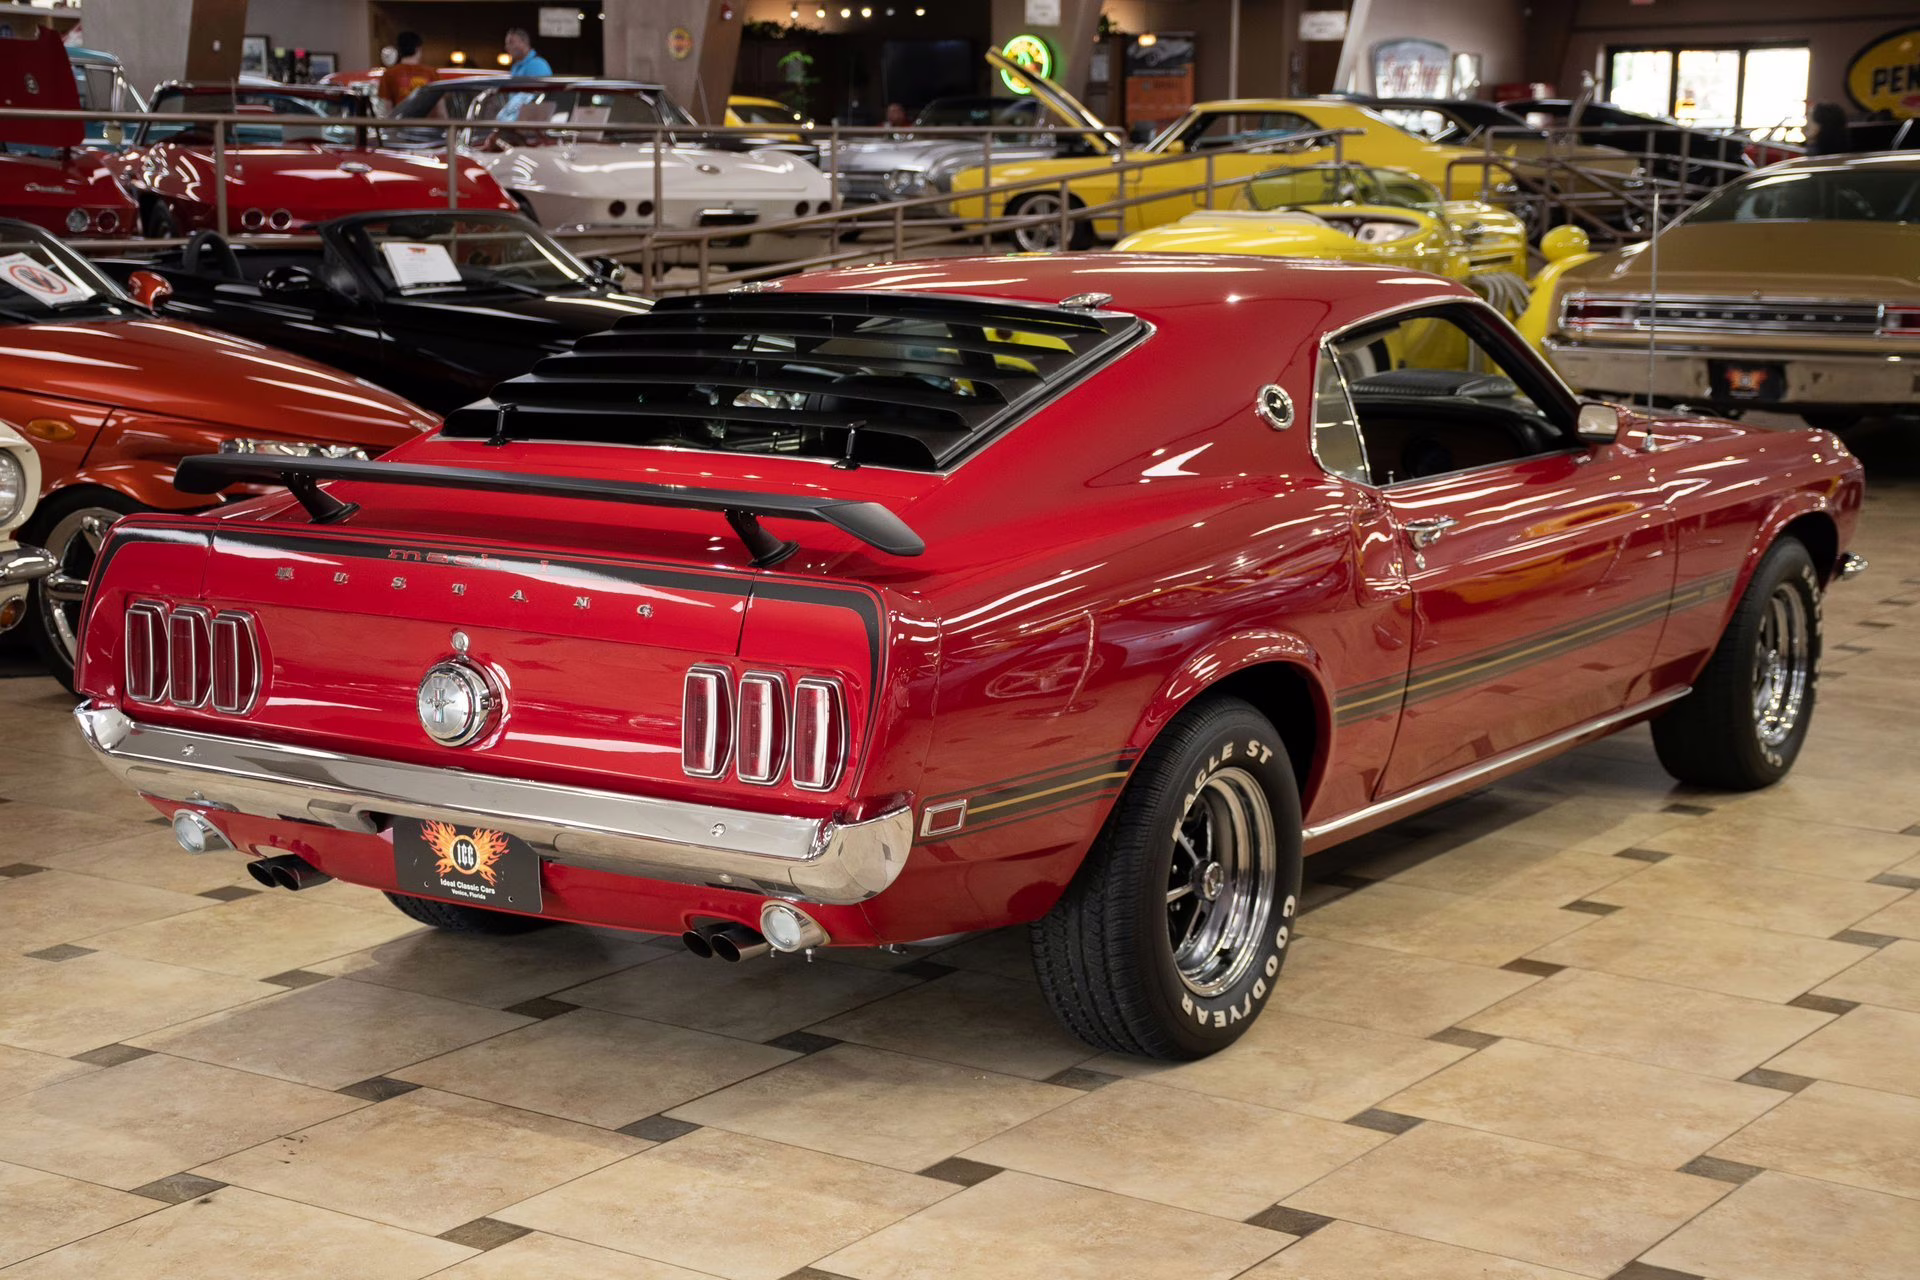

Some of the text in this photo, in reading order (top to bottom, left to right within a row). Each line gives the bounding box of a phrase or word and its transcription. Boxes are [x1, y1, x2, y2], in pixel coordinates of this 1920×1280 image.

[388, 548, 501, 570] mach
[275, 566, 655, 618] MUSTANG
[1245, 739, 1273, 765] ST
[440, 878, 496, 894] Ideal Classic Cars
[469, 891, 487, 900] Florida
[1182, 894, 1296, 1029] GOODYEAR
